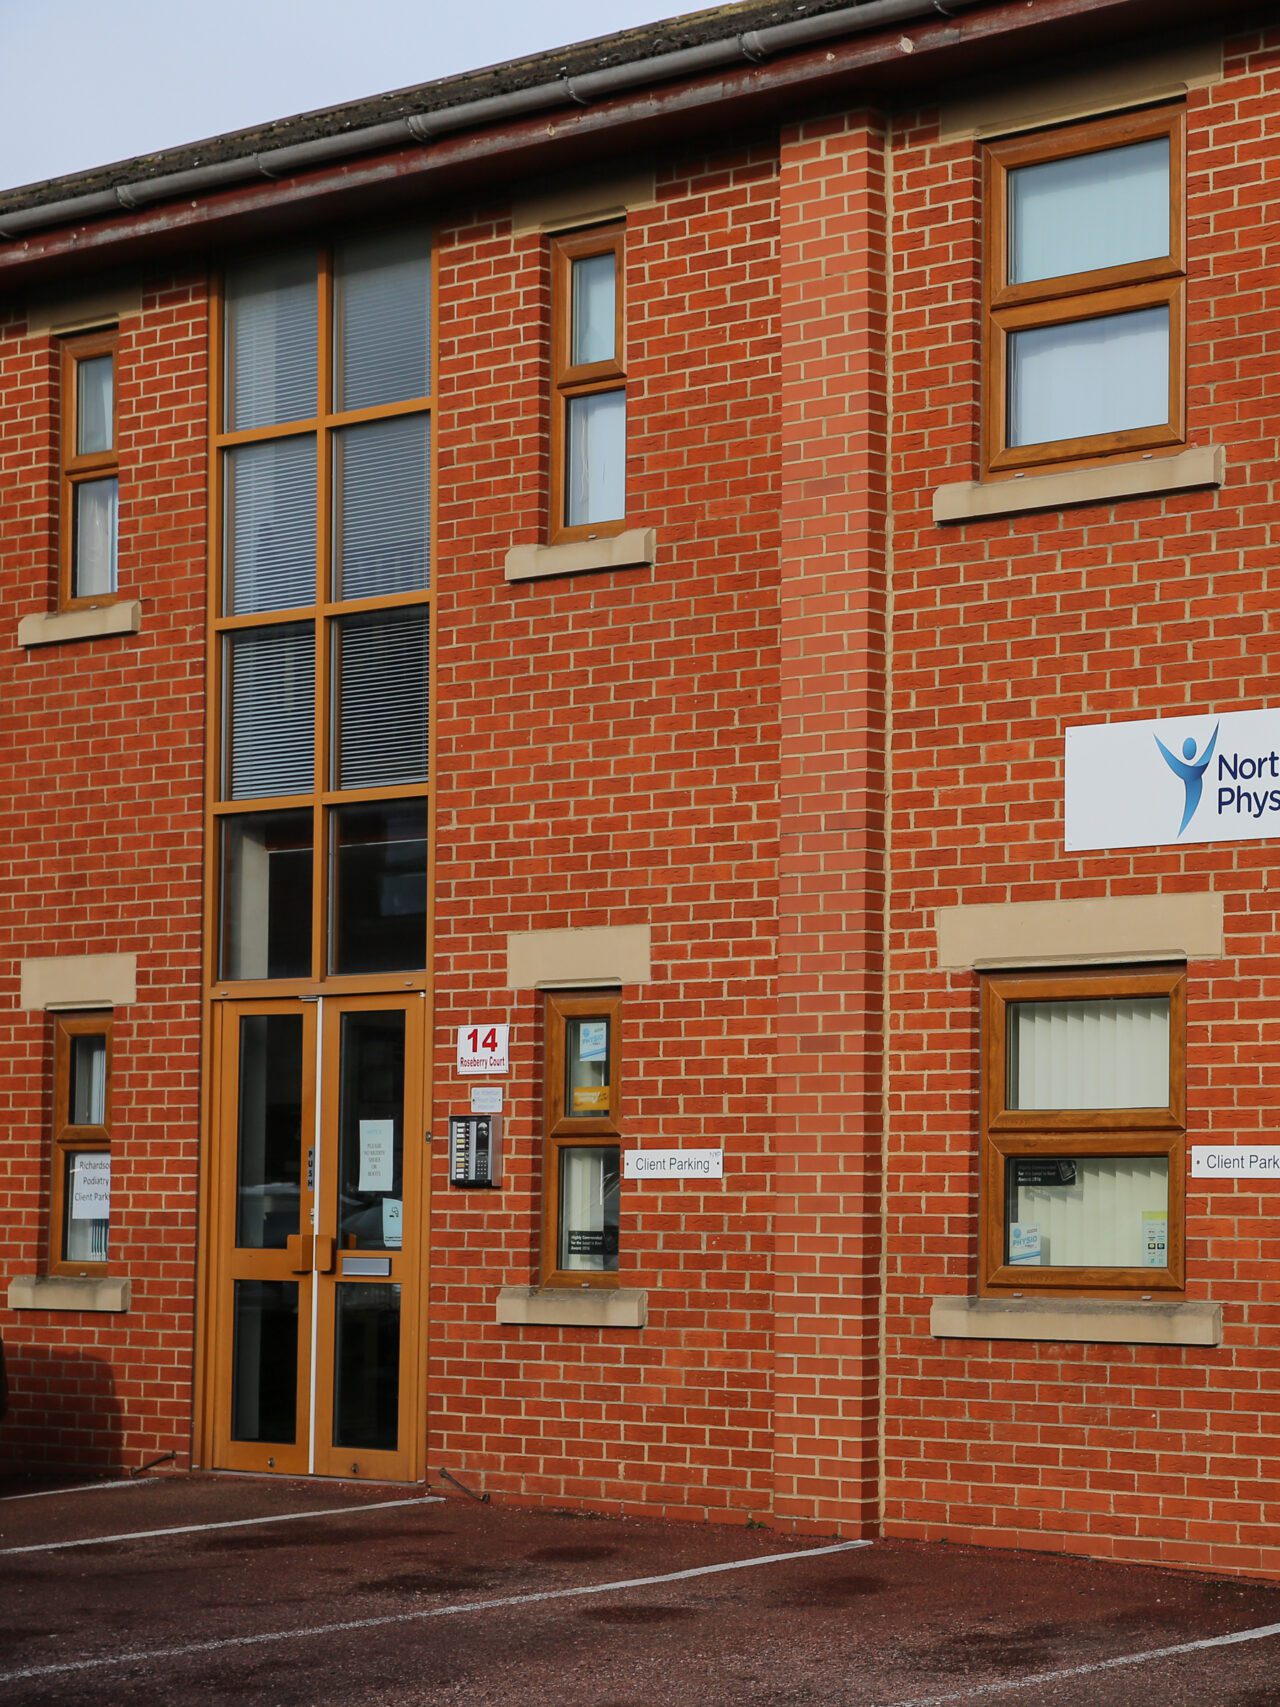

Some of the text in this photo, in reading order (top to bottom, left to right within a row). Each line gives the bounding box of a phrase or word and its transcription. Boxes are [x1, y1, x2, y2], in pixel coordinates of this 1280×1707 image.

[467, 1027, 498, 1053] 14
[460, 1056, 505, 1069] Roseberry Court
[636, 1157, 710, 1174] Client Parking
[1206, 1154, 1245, 1169] Client
[83, 1176, 110, 1186] Podiatry
[75, 1192, 110, 1201] Client Park
